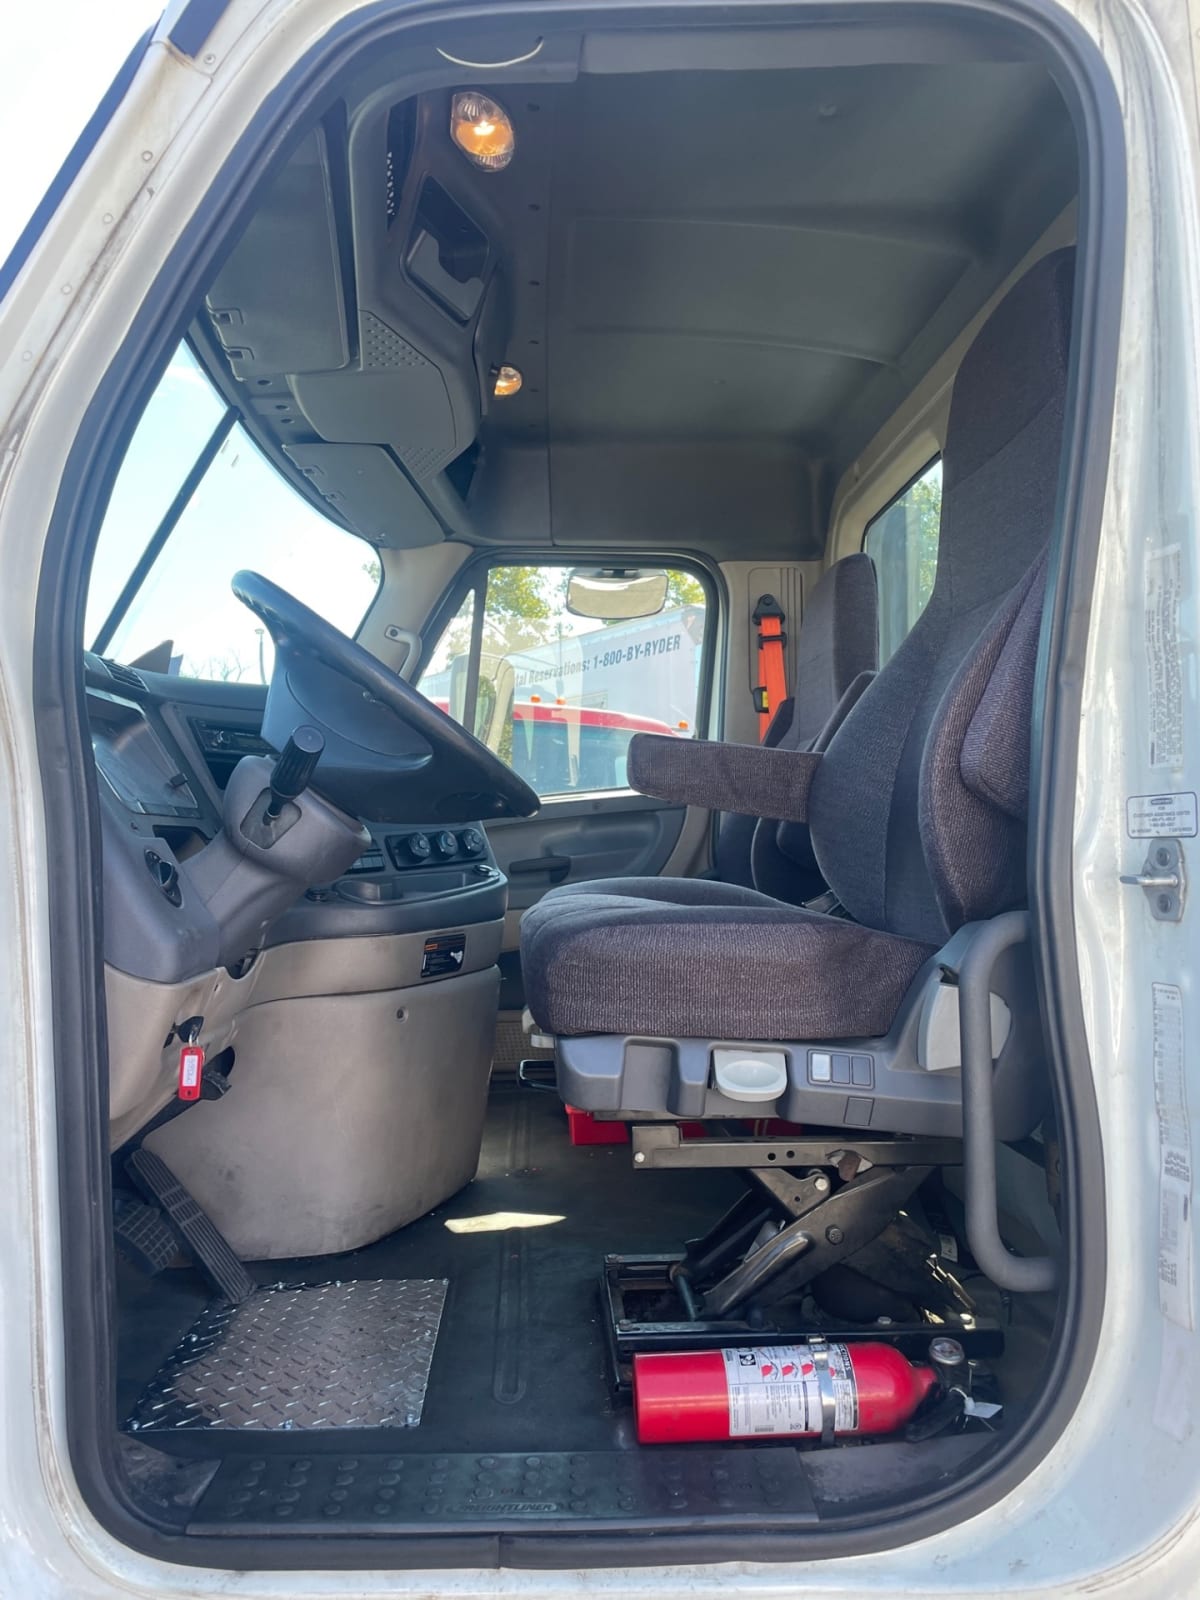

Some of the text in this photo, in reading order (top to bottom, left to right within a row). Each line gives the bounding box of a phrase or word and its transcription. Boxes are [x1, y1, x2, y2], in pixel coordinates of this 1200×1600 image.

[515, 634, 681, 687] tal Reservations: 1-800-BY-RYDER
